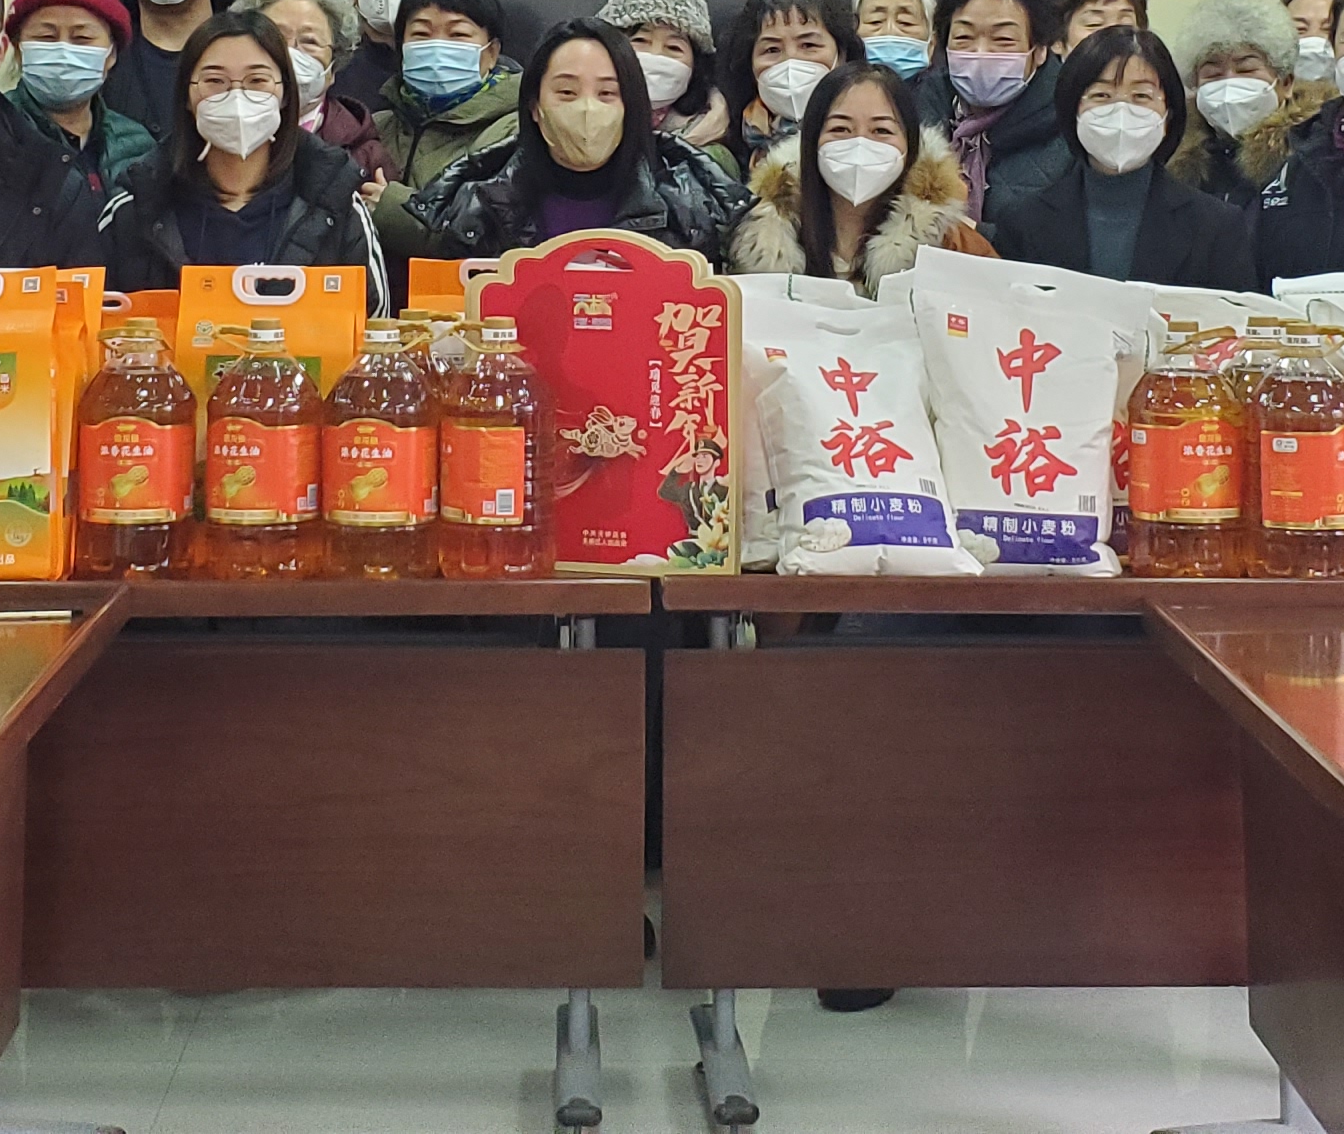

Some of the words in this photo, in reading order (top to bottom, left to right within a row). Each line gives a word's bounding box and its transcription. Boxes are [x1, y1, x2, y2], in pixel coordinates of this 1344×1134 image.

[818, 357, 914, 479] 中裕
[984, 328, 1078, 498] 中裕
[983, 515, 1076, 536] 精制小麦粉
